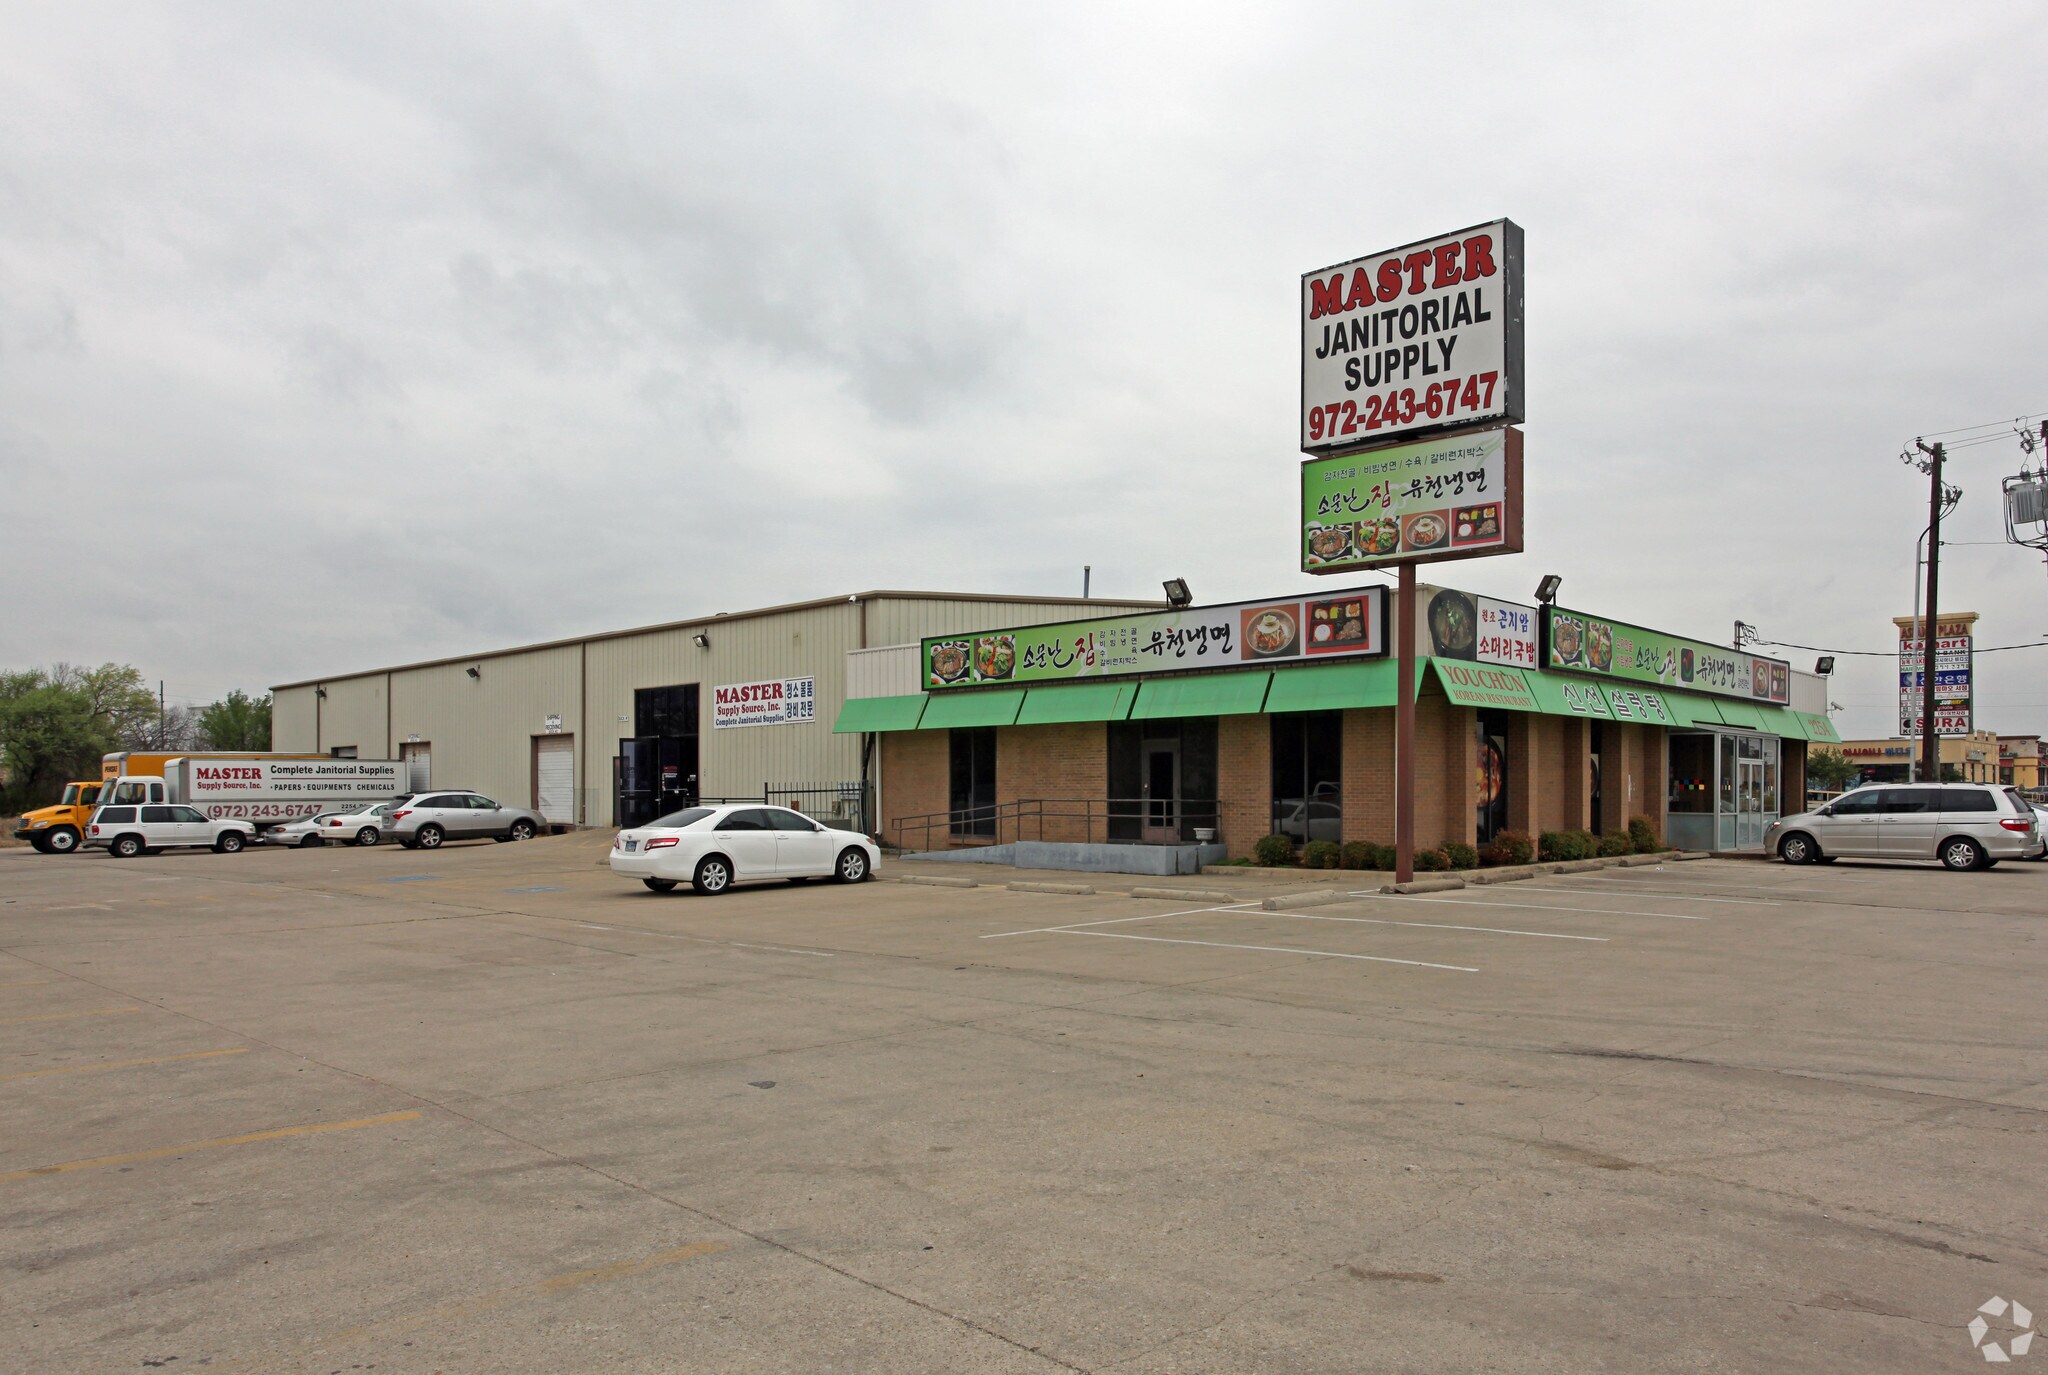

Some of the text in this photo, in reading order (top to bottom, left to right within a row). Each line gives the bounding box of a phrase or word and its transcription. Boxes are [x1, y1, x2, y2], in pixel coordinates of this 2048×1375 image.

[1310, 234, 1496, 319] MASTER
[1315, 287, 1491, 360] JANITORIAL
[1344, 334, 1458, 392] SUPPLY
[1309, 370, 1498, 440] 972-243-6747
[1364, 460, 1397, 474] 비빔냉면
[1405, 456, 1422, 468] 수육
[1401, 468, 1487, 498] 유천냉면
[1482, 609, 1528, 632] 원조 곤지암
[1938, 624, 1968, 636] PLAZA
[1140, 623, 1233, 657] 유천냉면
[1478, 636, 1535, 662] 소머리국밥
[1441, 664, 1526, 692] YOUCHUN
[1696, 656, 1736, 688] 유천냉면
[716, 682, 784, 704] MASTER
[1453, 690, 1532, 707] KOREAN RESTAURANT
[716, 714, 784, 726] Complete Janitorial Supplies
[718, 702, 780, 717] Supply Source, Inc.
[1808, 719, 1832, 736] 2254
[196, 768, 262, 780] MASTER
[270, 764, 394, 776] Complete Janitorial Supplies
[198, 782, 221, 790] Supply
[223, 782, 248, 790] Source,
[208, 804, 322, 818] (972) 243-6747
